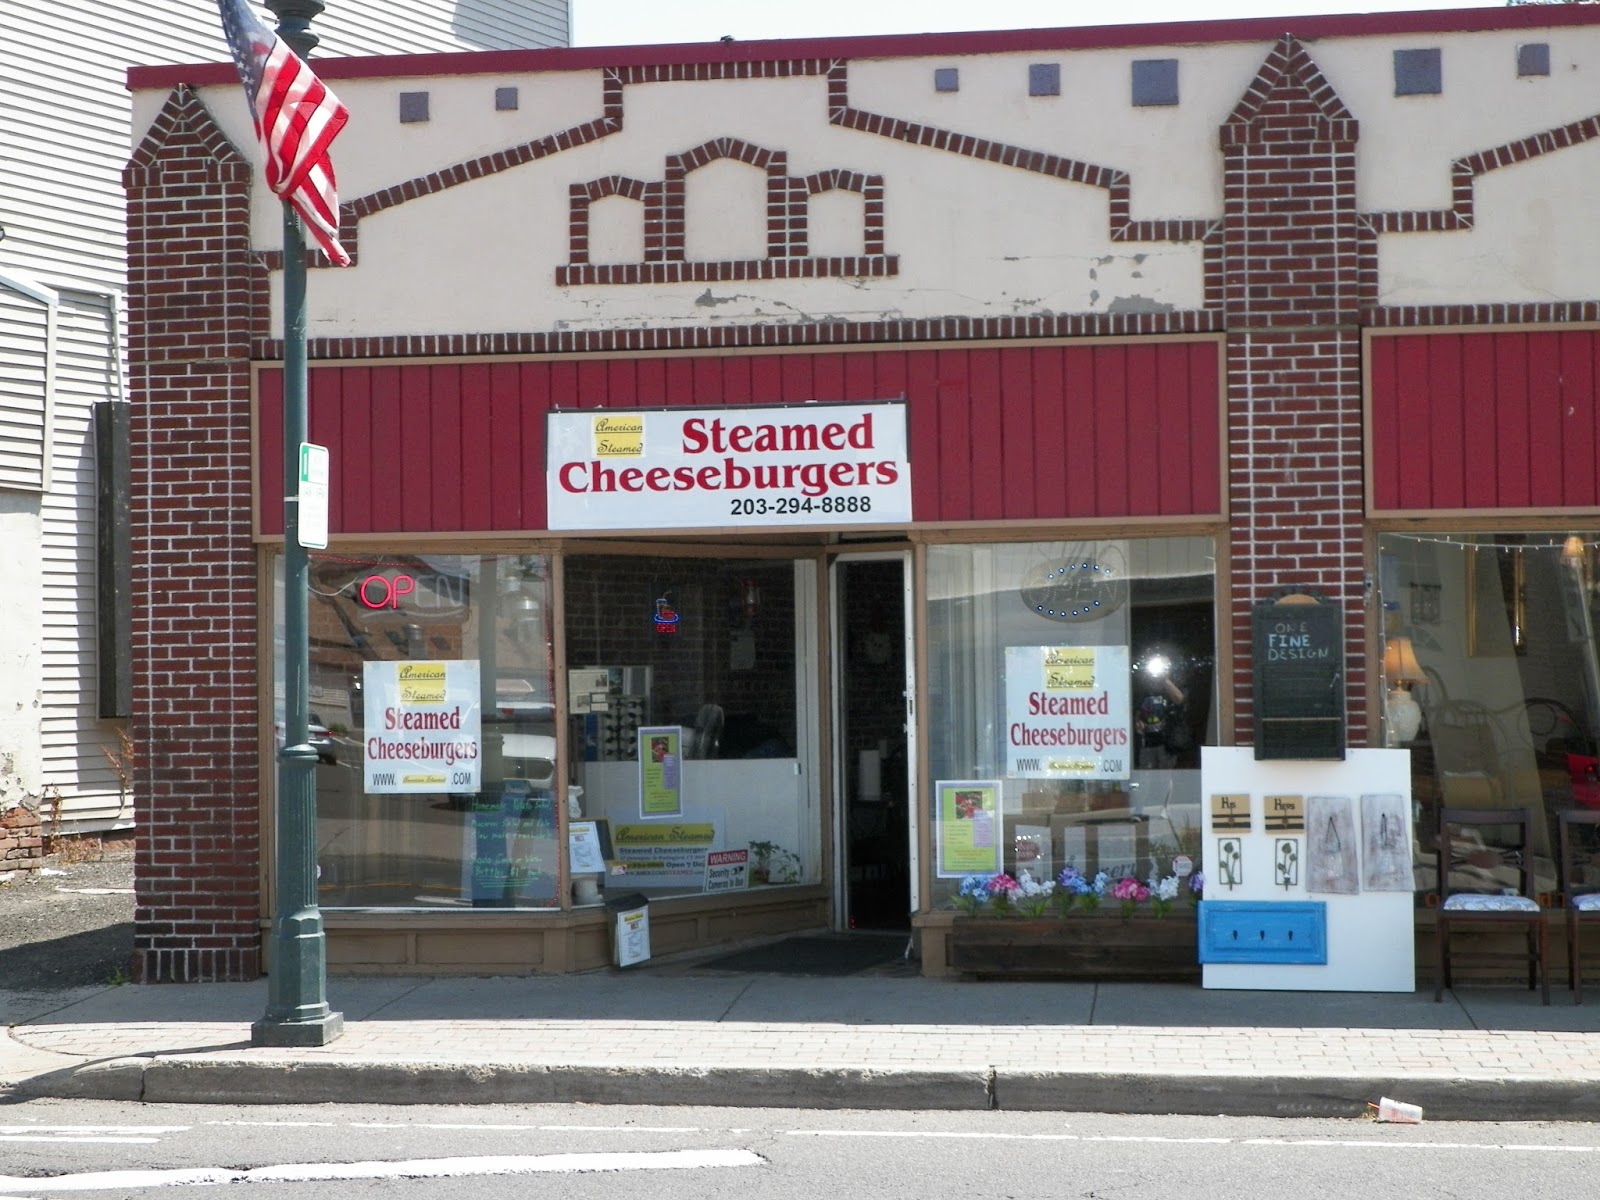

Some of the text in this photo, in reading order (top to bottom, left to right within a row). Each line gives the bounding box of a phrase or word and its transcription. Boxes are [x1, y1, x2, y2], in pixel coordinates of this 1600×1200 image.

[595, 417, 643, 432] American
[682, 412, 875, 454] Steamed
[597, 439, 644, 453] Steamed
[558, 457, 899, 497] Cheeseburgers
[730, 496, 871, 516] 203-294-8888
[360, 574, 464, 609] OPEN
[1274, 621, 1308, 633] ONE
[1268, 633, 1311, 648] FINE
[1268, 647, 1329, 661] DESIGN
[399, 665, 446, 679] American
[401, 686, 447, 700] Steamed
[1028, 690, 1109, 716] Steamed
[385, 705, 461, 731] Steamed
[1010, 722, 1128, 753] Cheeseburgers
[367, 736, 478, 766] Cheeseburgers
[1101, 759, 1123, 773] .COM
[451, 772, 472, 785] .COM
[1221, 796, 1237, 809] His
[1274, 798, 1296, 811] Hers
[615, 826, 665, 841] American
[710, 851, 746, 864] WARNING
[709, 867, 729, 879] Security
